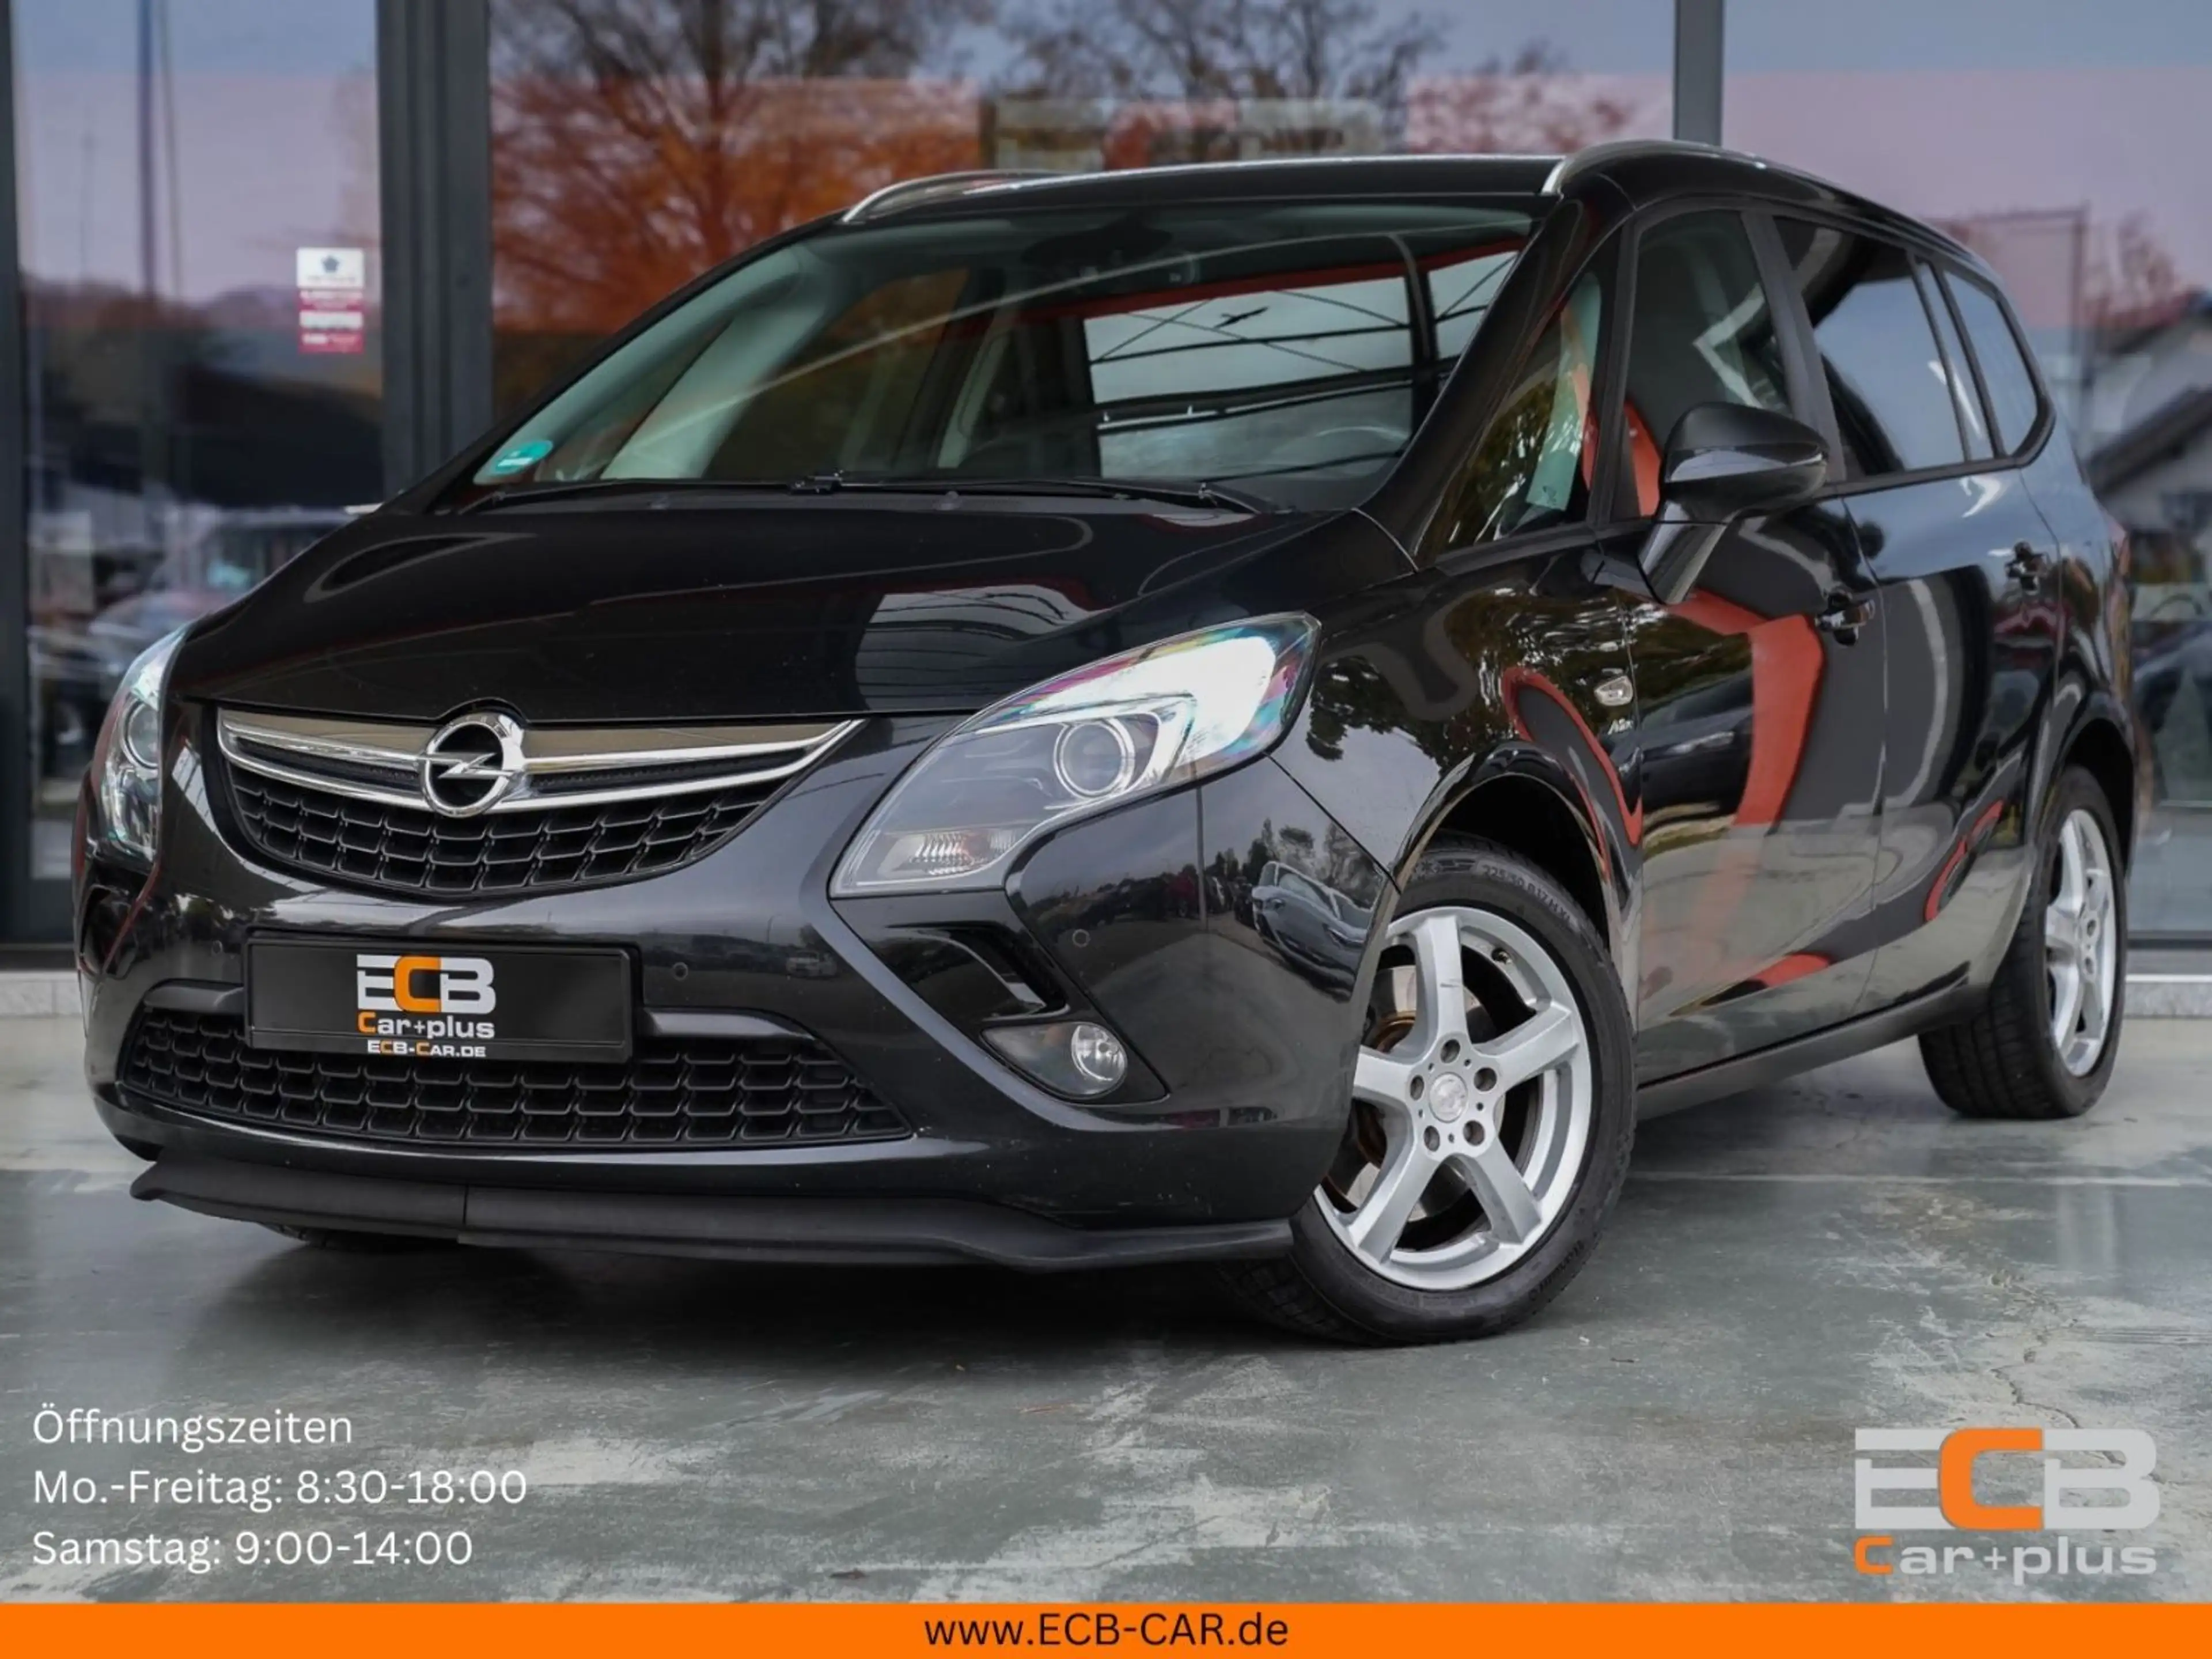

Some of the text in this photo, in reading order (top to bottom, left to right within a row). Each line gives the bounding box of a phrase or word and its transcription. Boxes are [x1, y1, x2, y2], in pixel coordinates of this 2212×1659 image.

[357, 954, 496, 1014] ECB
[358, 1011, 495, 1039] Car+plus
[367, 1039, 486, 1058] ECB-CAR.DE
